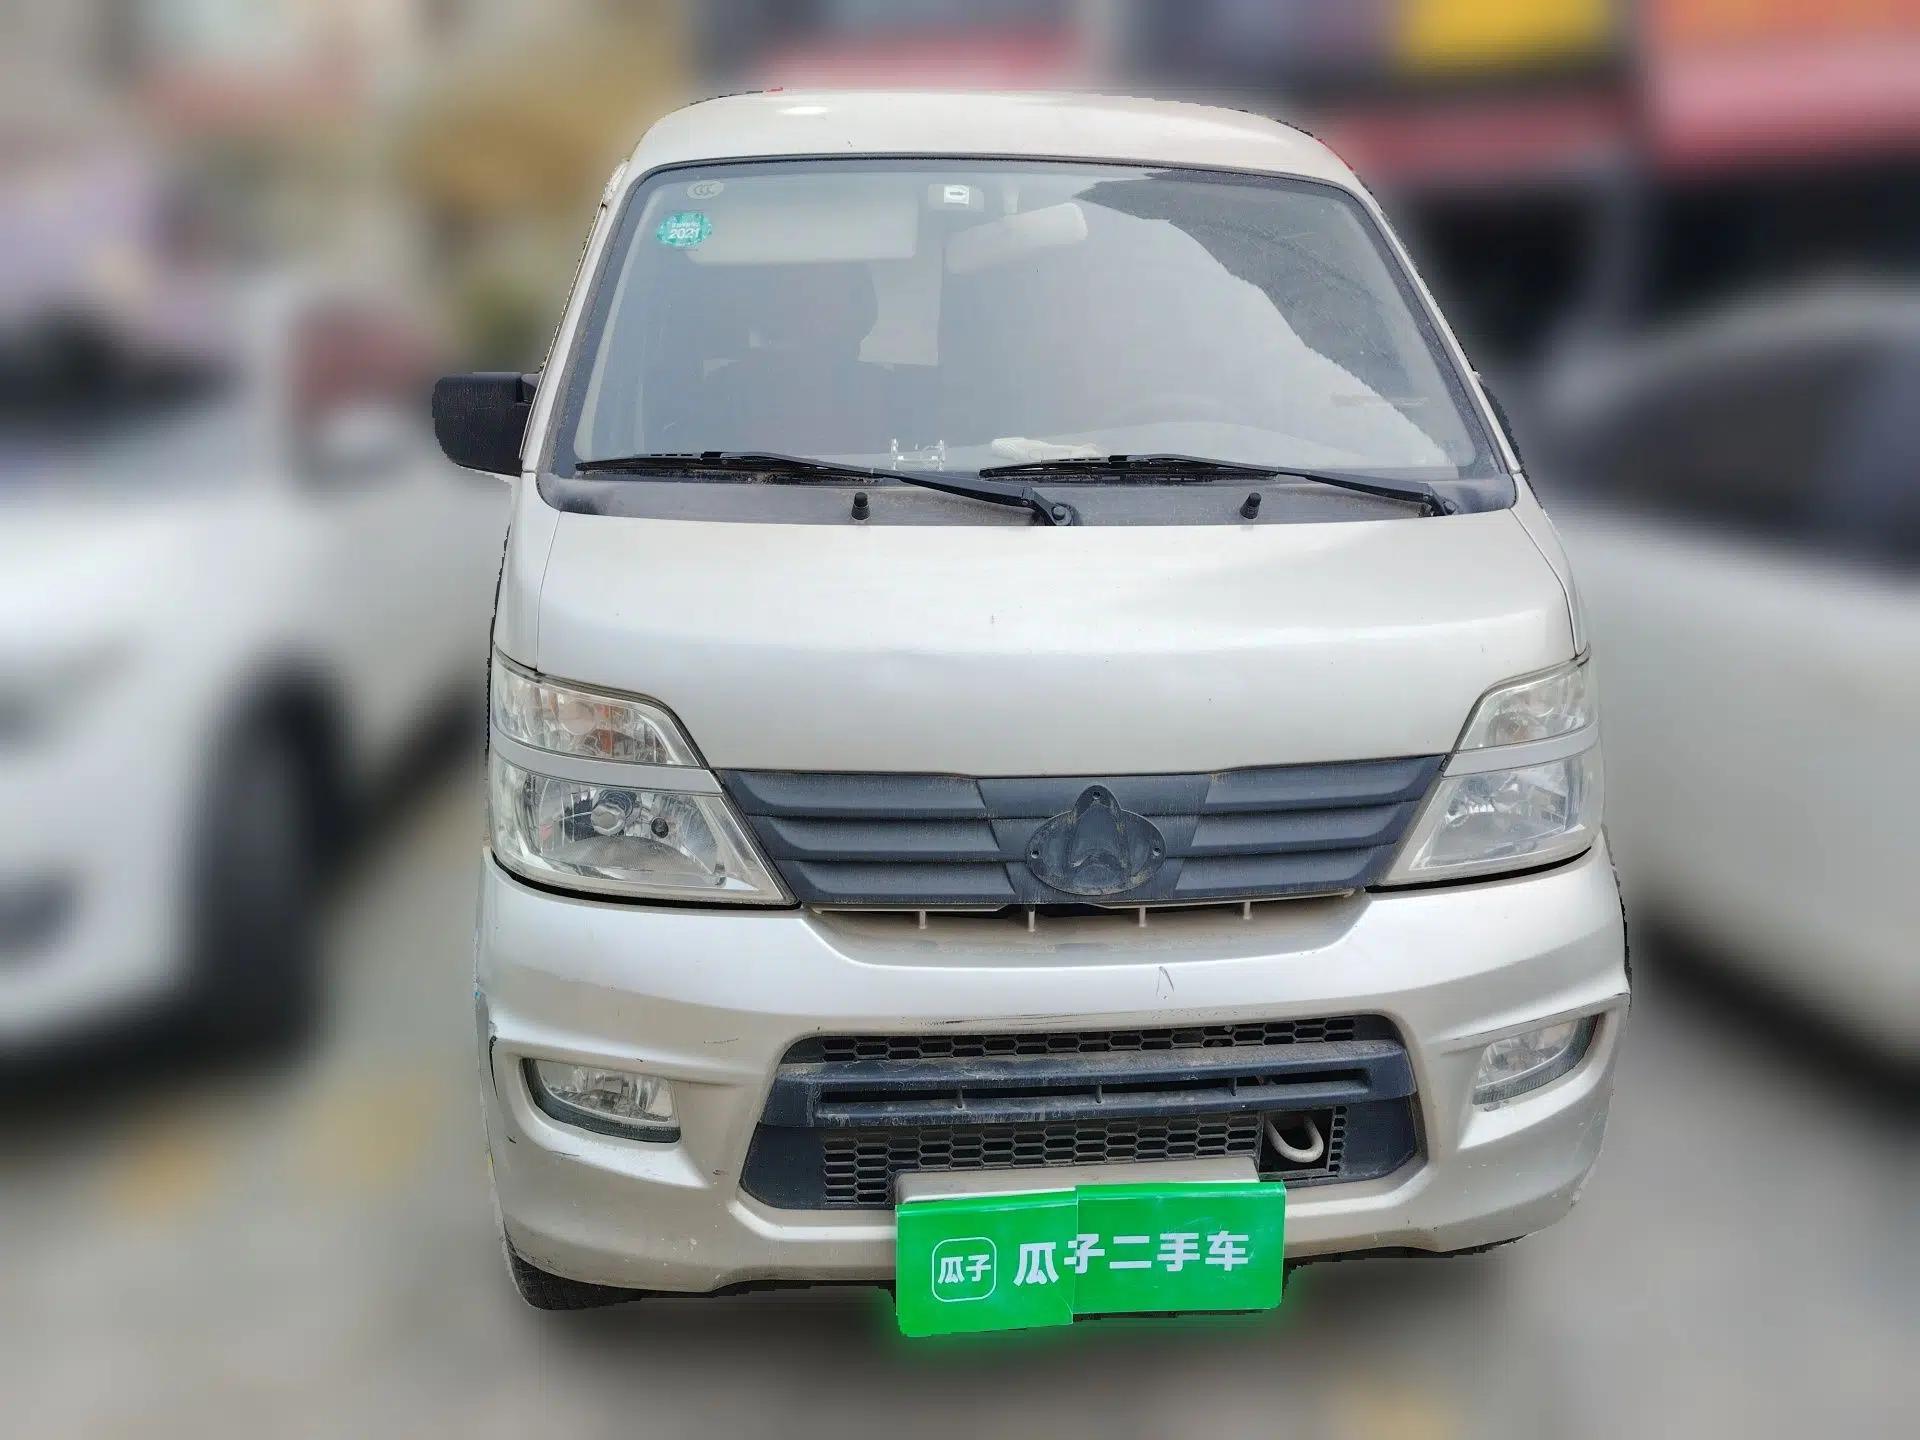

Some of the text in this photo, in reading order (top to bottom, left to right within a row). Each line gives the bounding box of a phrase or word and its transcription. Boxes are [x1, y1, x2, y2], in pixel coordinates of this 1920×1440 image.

[668, 228, 700, 239] 2021
[937, 1253, 991, 1284] 瓜子
[1013, 1230, 1249, 1287] 瓜子二手车
